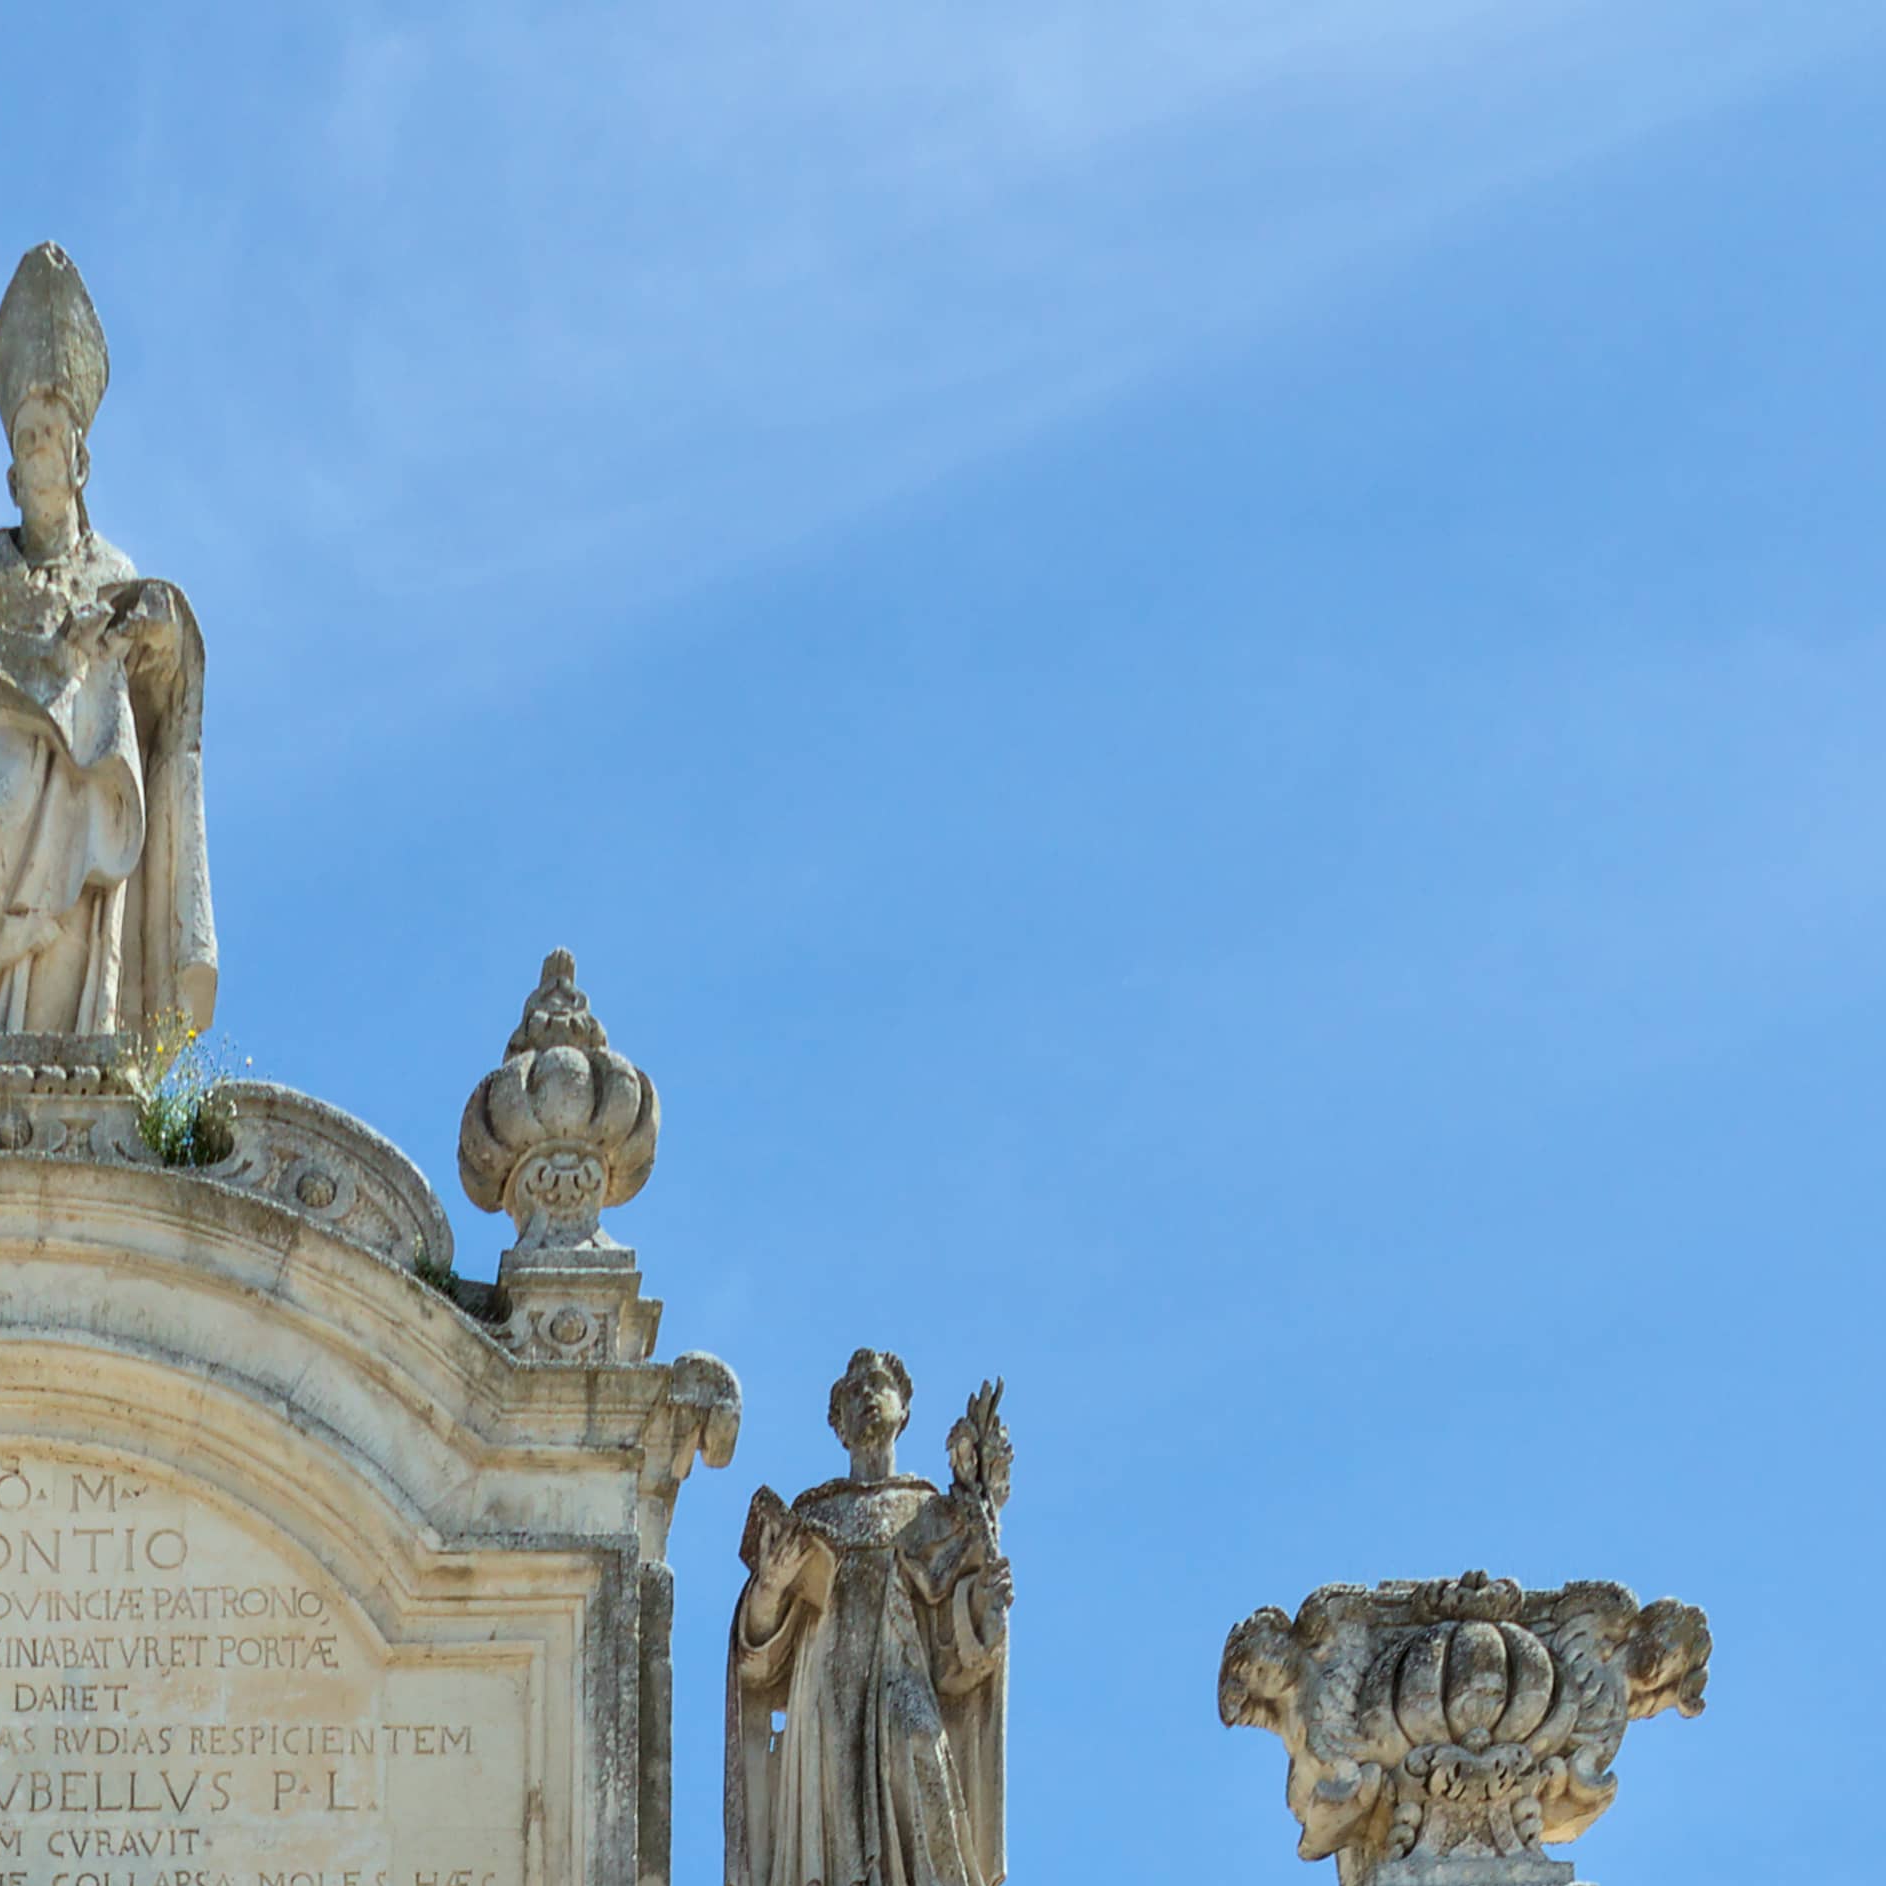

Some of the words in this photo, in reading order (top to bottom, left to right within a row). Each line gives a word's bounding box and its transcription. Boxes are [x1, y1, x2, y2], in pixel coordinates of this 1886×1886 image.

[216, 1634, 340, 1669] PORTÆ
[52, 1726, 173, 1756] RVDIAS
[188, 1724, 473, 1756] RESPICIENTEM
